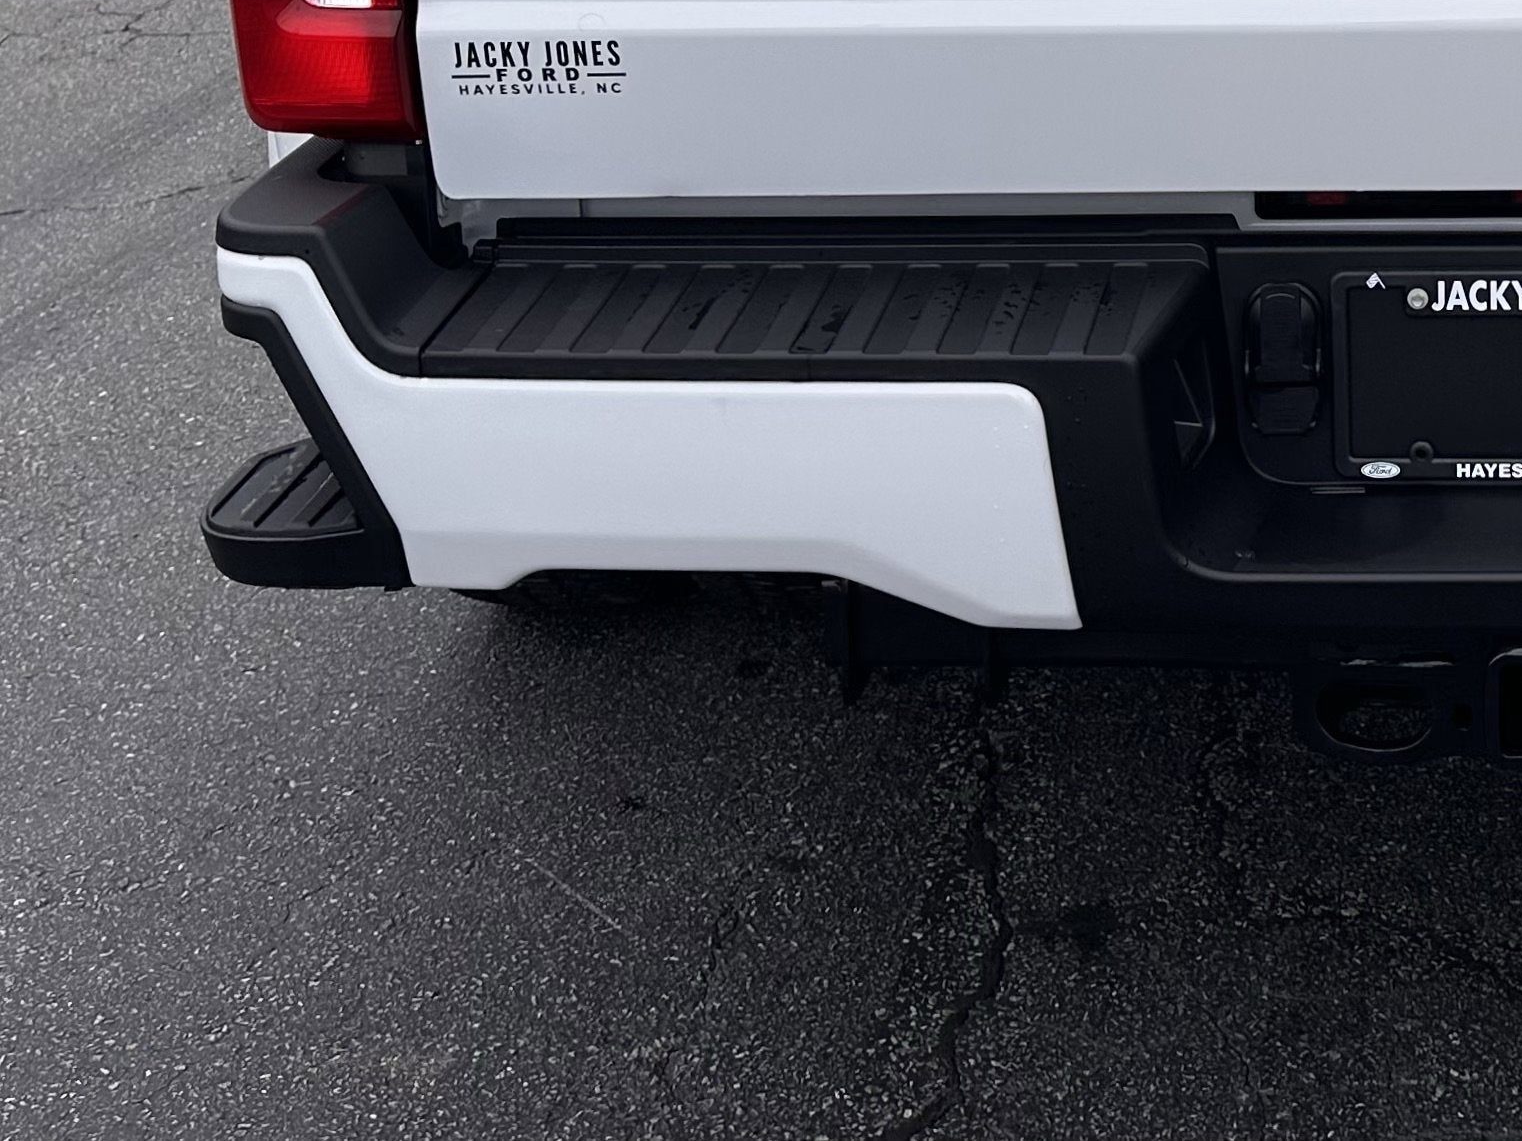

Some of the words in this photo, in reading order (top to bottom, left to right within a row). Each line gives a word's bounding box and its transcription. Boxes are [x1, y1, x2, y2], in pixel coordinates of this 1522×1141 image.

[454, 41, 530, 68] JACKY
[544, 40, 621, 66] JONES
[496, 67, 580, 82] FORD
[459, 83, 585, 95] HAYESVILLE,
[596, 82, 622, 94] NC
